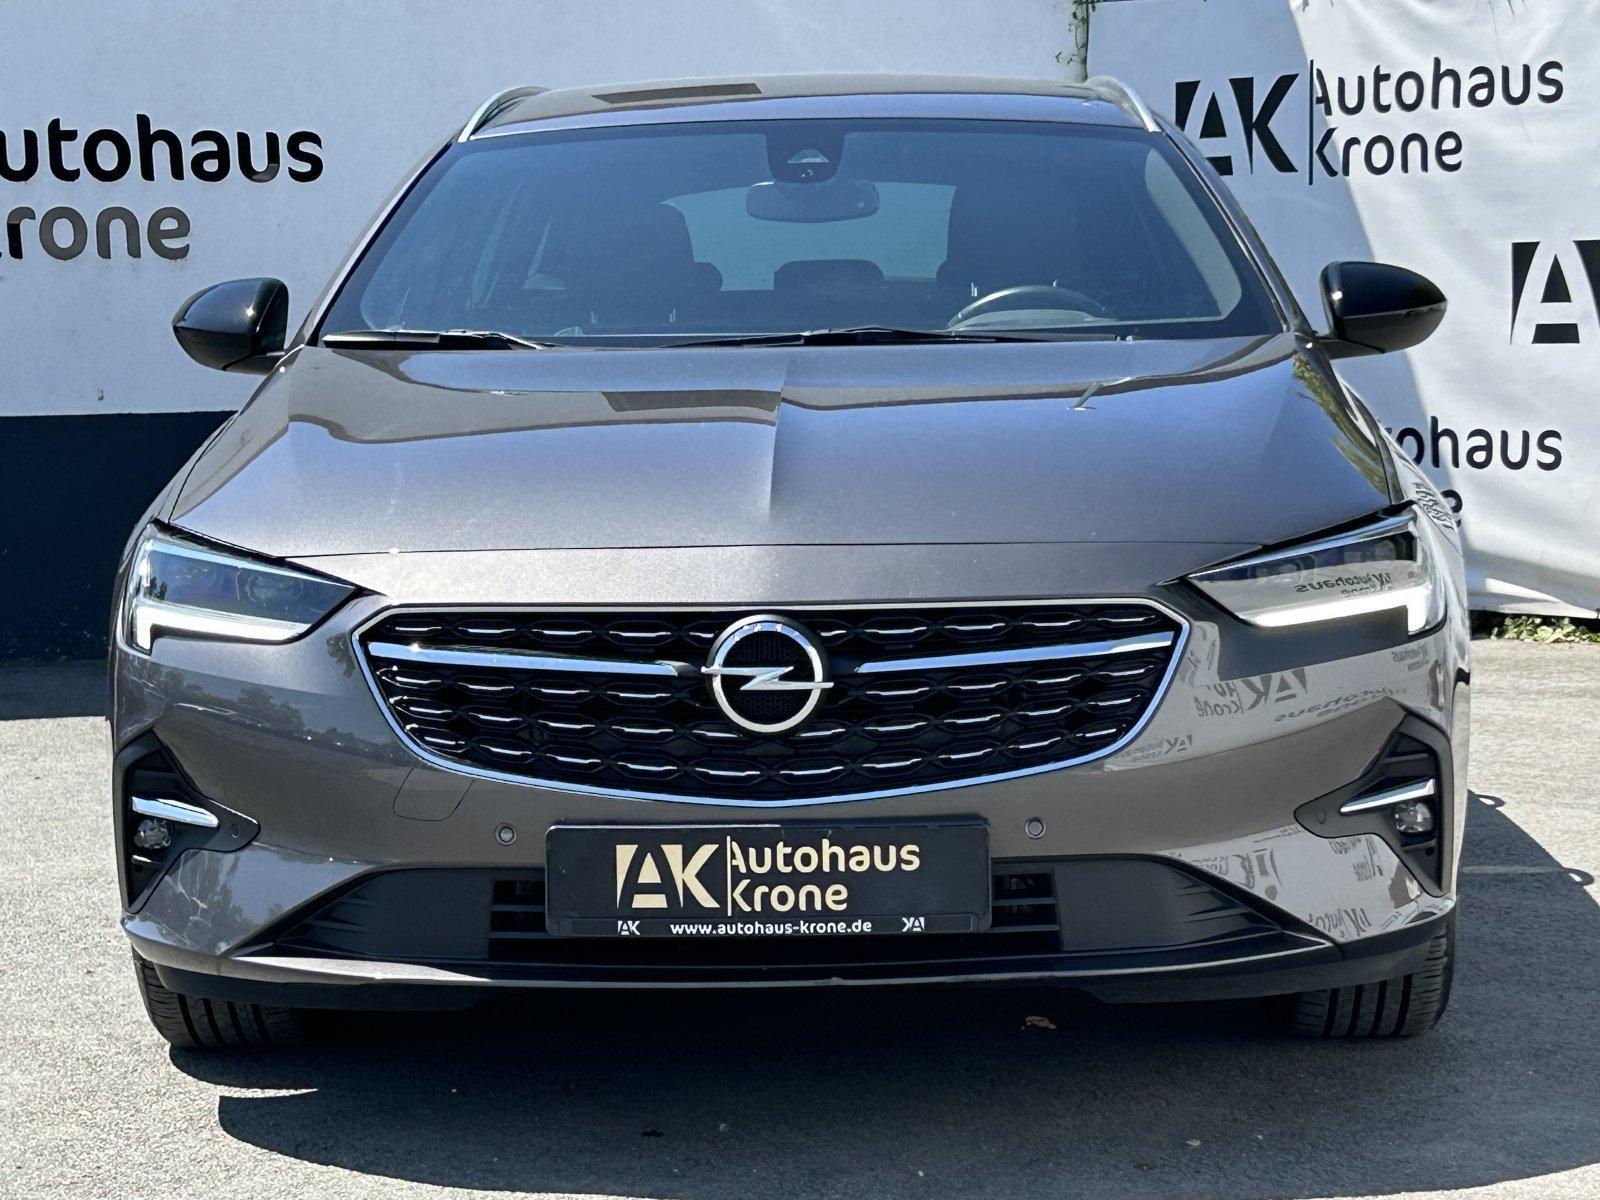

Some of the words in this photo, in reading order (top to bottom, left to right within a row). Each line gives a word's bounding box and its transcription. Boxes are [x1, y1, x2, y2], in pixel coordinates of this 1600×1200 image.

[1315, 57, 1564, 116] Autohaus
[1175, 73, 1299, 176] AK
[1315, 127, 1462, 177] Krone
[0, 206, 191, 260] rone
[1510, 239, 1600, 346] A
[1387, 416, 1562, 471] ohaus
[616, 844, 720, 909] AK
[731, 838, 921, 874] Autohaus
[731, 878, 849, 912] Krone
[617, 920, 641, 936] AK
[670, 919, 873, 935] www.autohaus-krone.de
